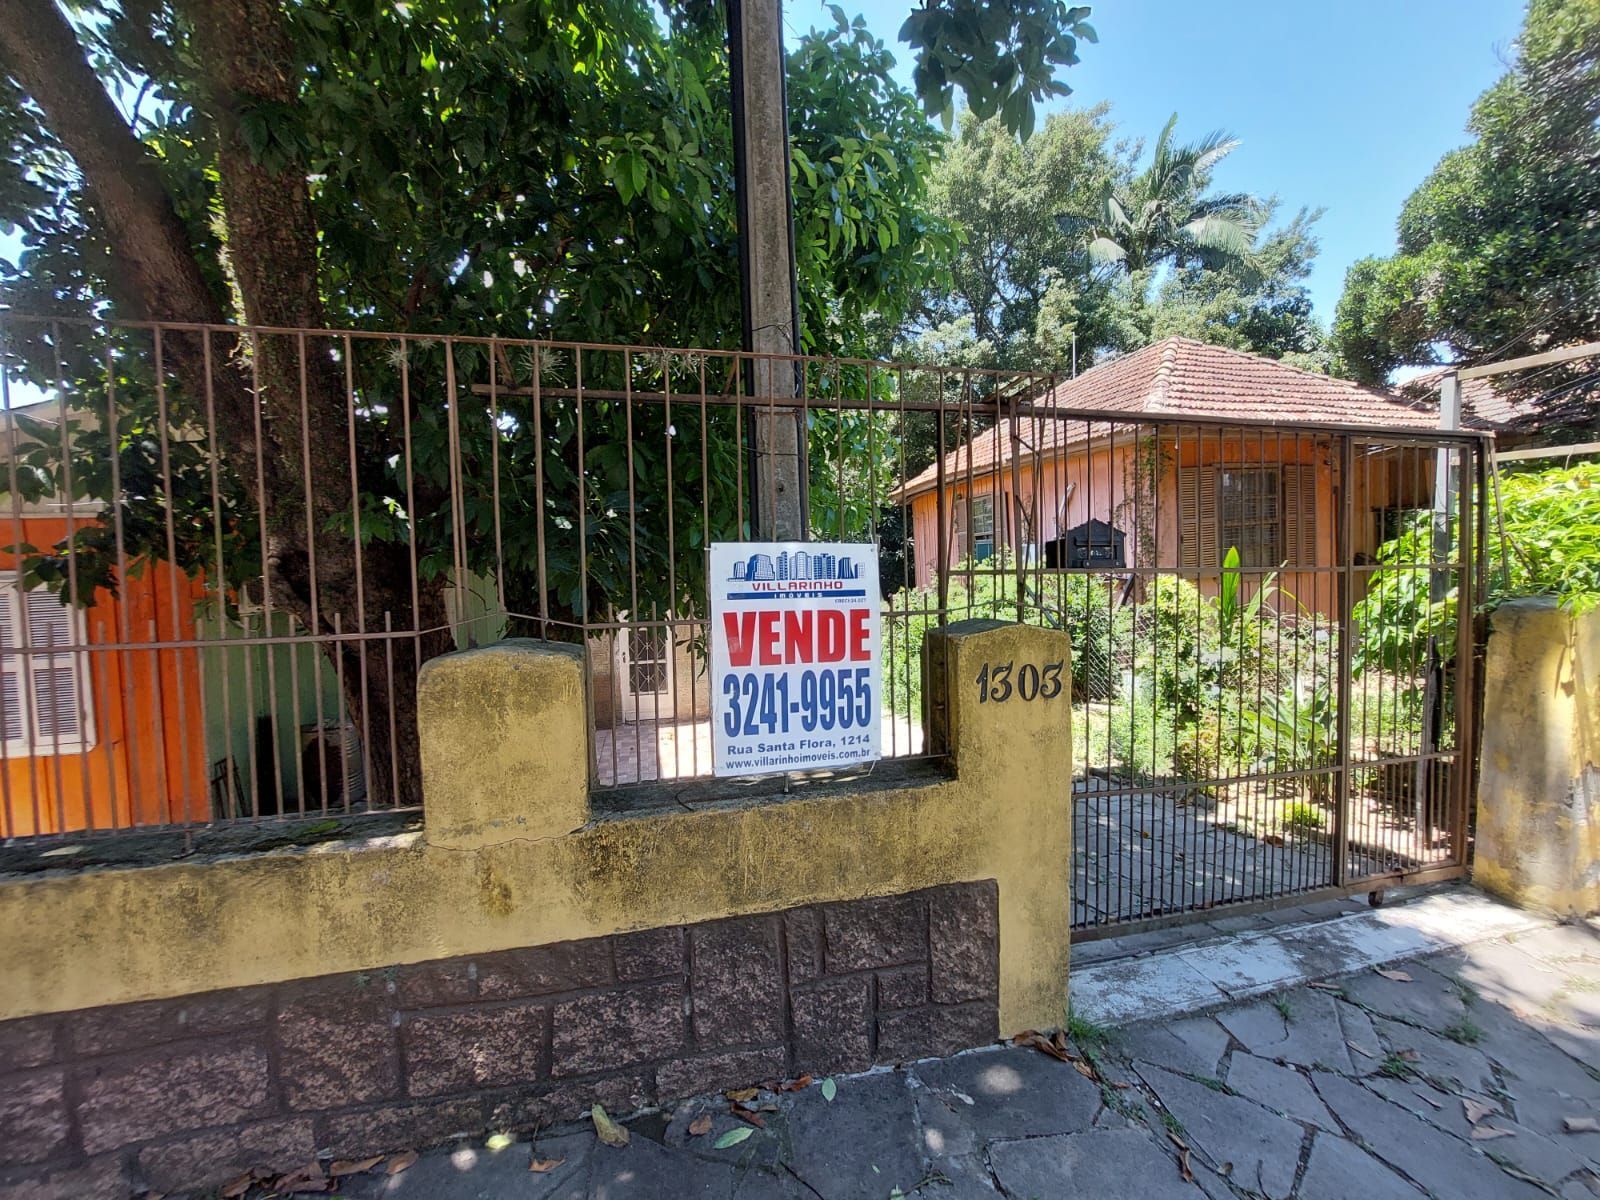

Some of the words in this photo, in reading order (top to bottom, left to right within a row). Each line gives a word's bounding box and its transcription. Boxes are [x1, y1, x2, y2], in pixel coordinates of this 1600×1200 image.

[752, 581, 843, 591] VILLARINHO
[723, 609, 871, 667] VENDE
[976, 659, 1064, 704] 1303
[723, 668, 871, 737] 3241-9955
[726, 748, 870, 769] www.villarinhoimoveis.com.br
[727, 745, 753, 755] Rua
[757, 743, 795, 753] Santa
[800, 739, 836, 749] Flora,
[840, 734, 870, 746] 1214
